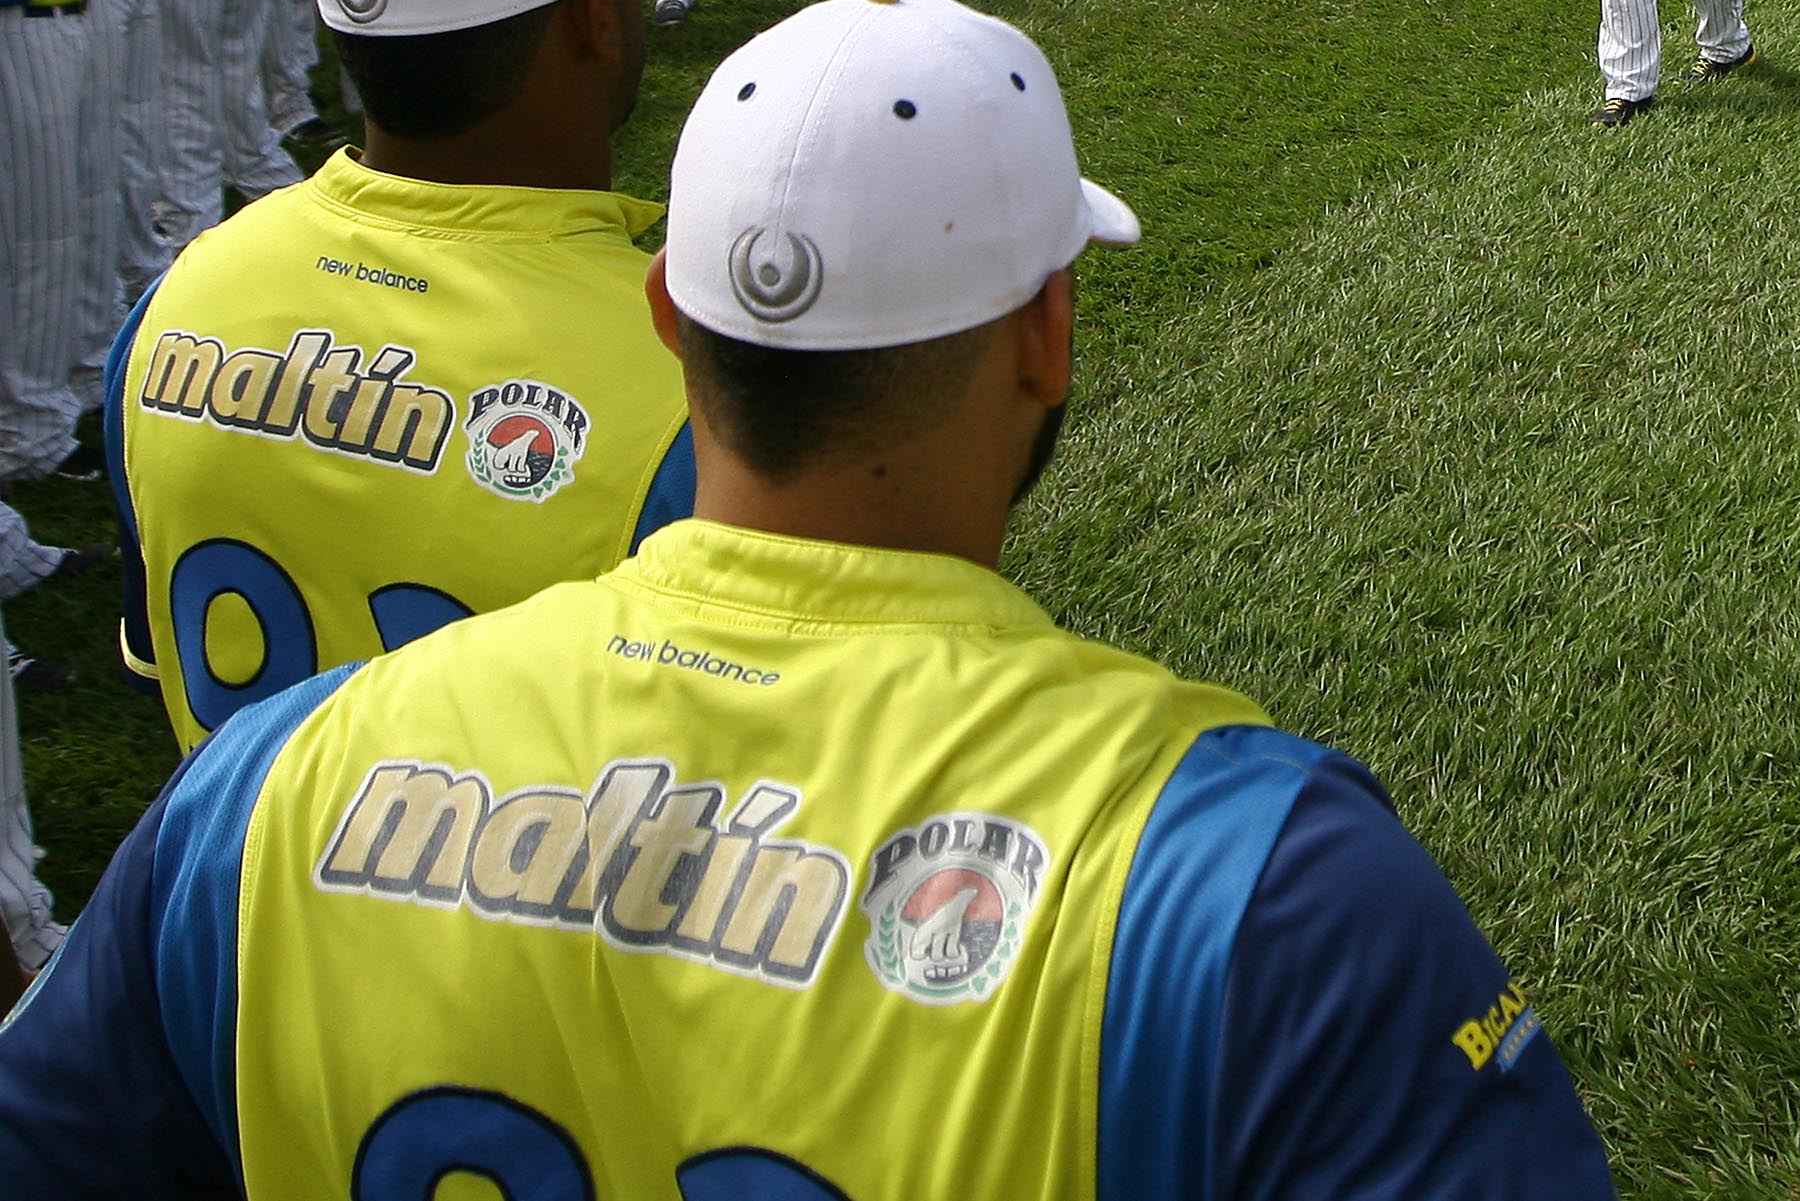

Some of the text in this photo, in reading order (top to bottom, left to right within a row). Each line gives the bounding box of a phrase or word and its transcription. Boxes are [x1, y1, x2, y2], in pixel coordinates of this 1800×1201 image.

[315, 253, 428, 294] new balance
[141, 329, 455, 475] maltín
[467, 383, 588, 452] POLAR
[606, 634, 781, 688] new balance
[313, 756, 853, 990] maltín
[872, 818, 1050, 897] POLAR
